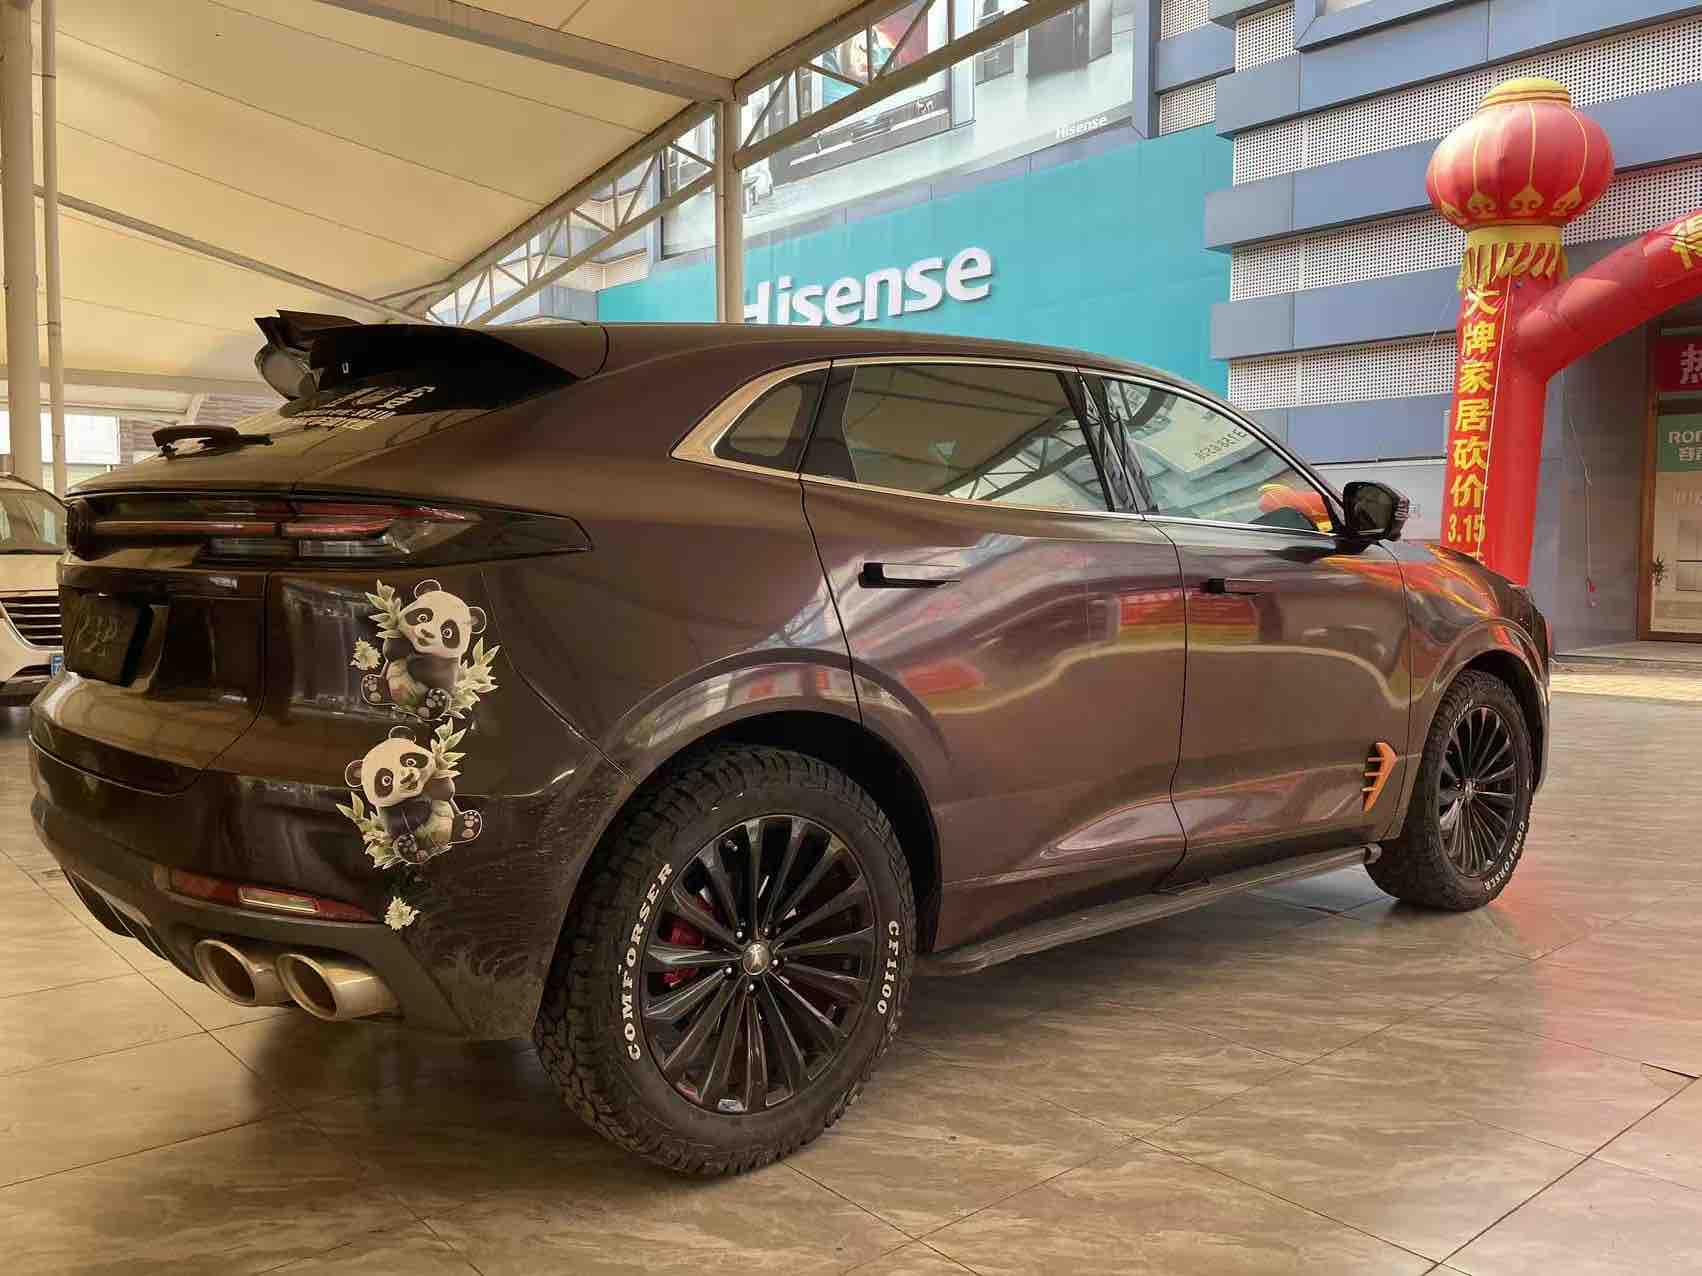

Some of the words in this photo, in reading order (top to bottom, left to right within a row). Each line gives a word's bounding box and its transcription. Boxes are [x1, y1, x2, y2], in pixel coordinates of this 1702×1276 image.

[1055, 116, 1107, 140] Hisense
[1447, 283, 1502, 563] 大牌家居砍价3.15
[622, 863, 673, 1061] COMFORSER
[877, 920, 900, 1015] CF1100
